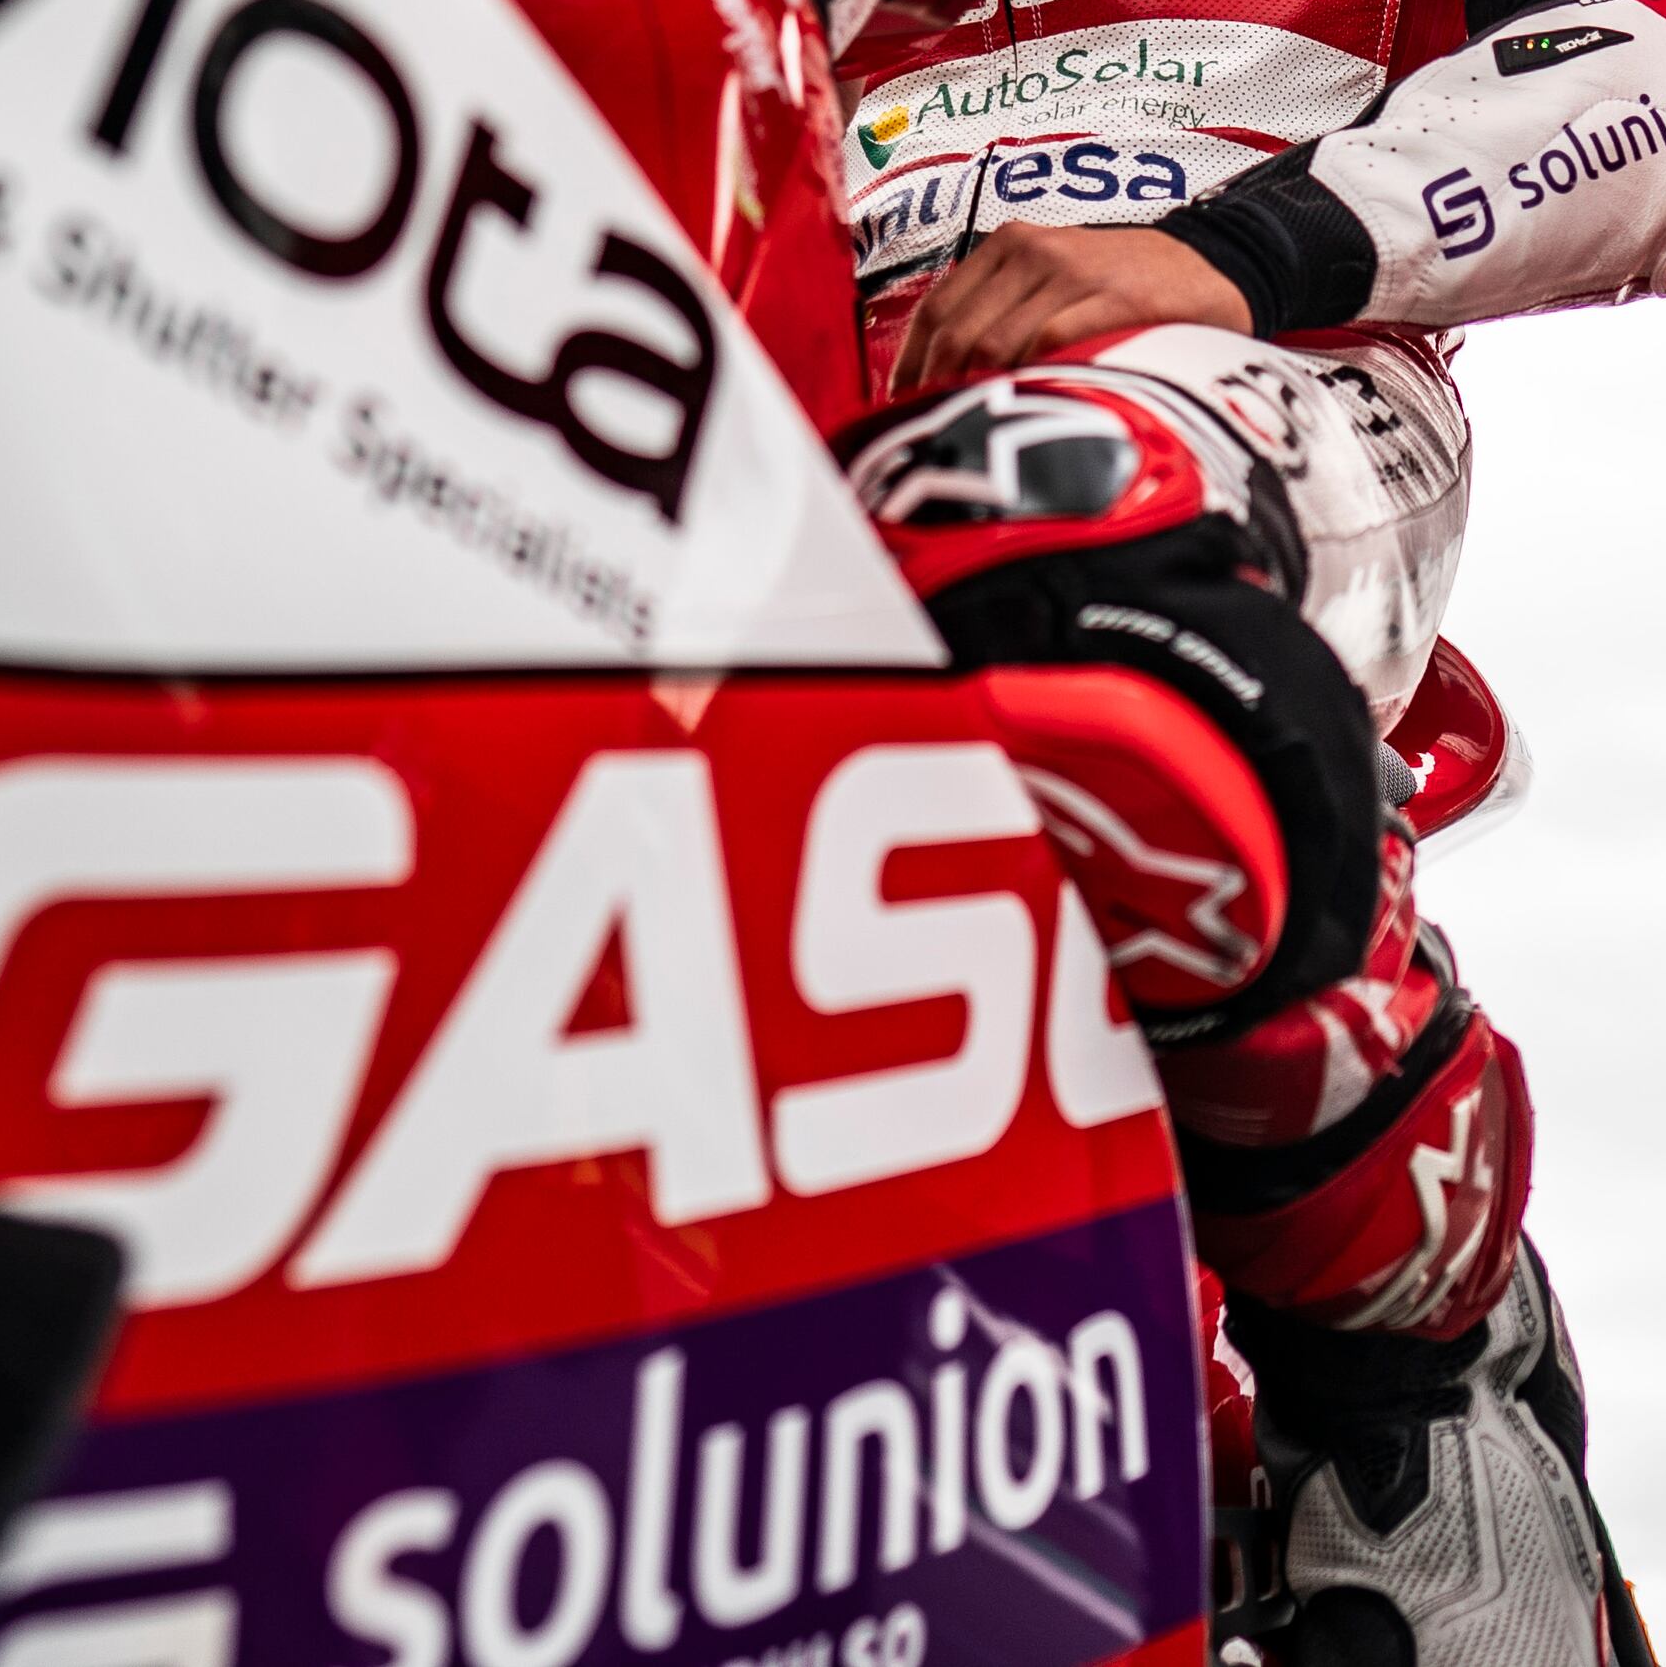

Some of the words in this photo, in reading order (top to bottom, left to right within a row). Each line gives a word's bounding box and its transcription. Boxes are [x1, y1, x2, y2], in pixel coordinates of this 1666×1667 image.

[918, 38, 1218, 127] AutoSolar
[1019, 101, 1087, 127] solar
[1101, 95, 1207, 131] energy
[326, 1289, 1153, 1667] solunion
